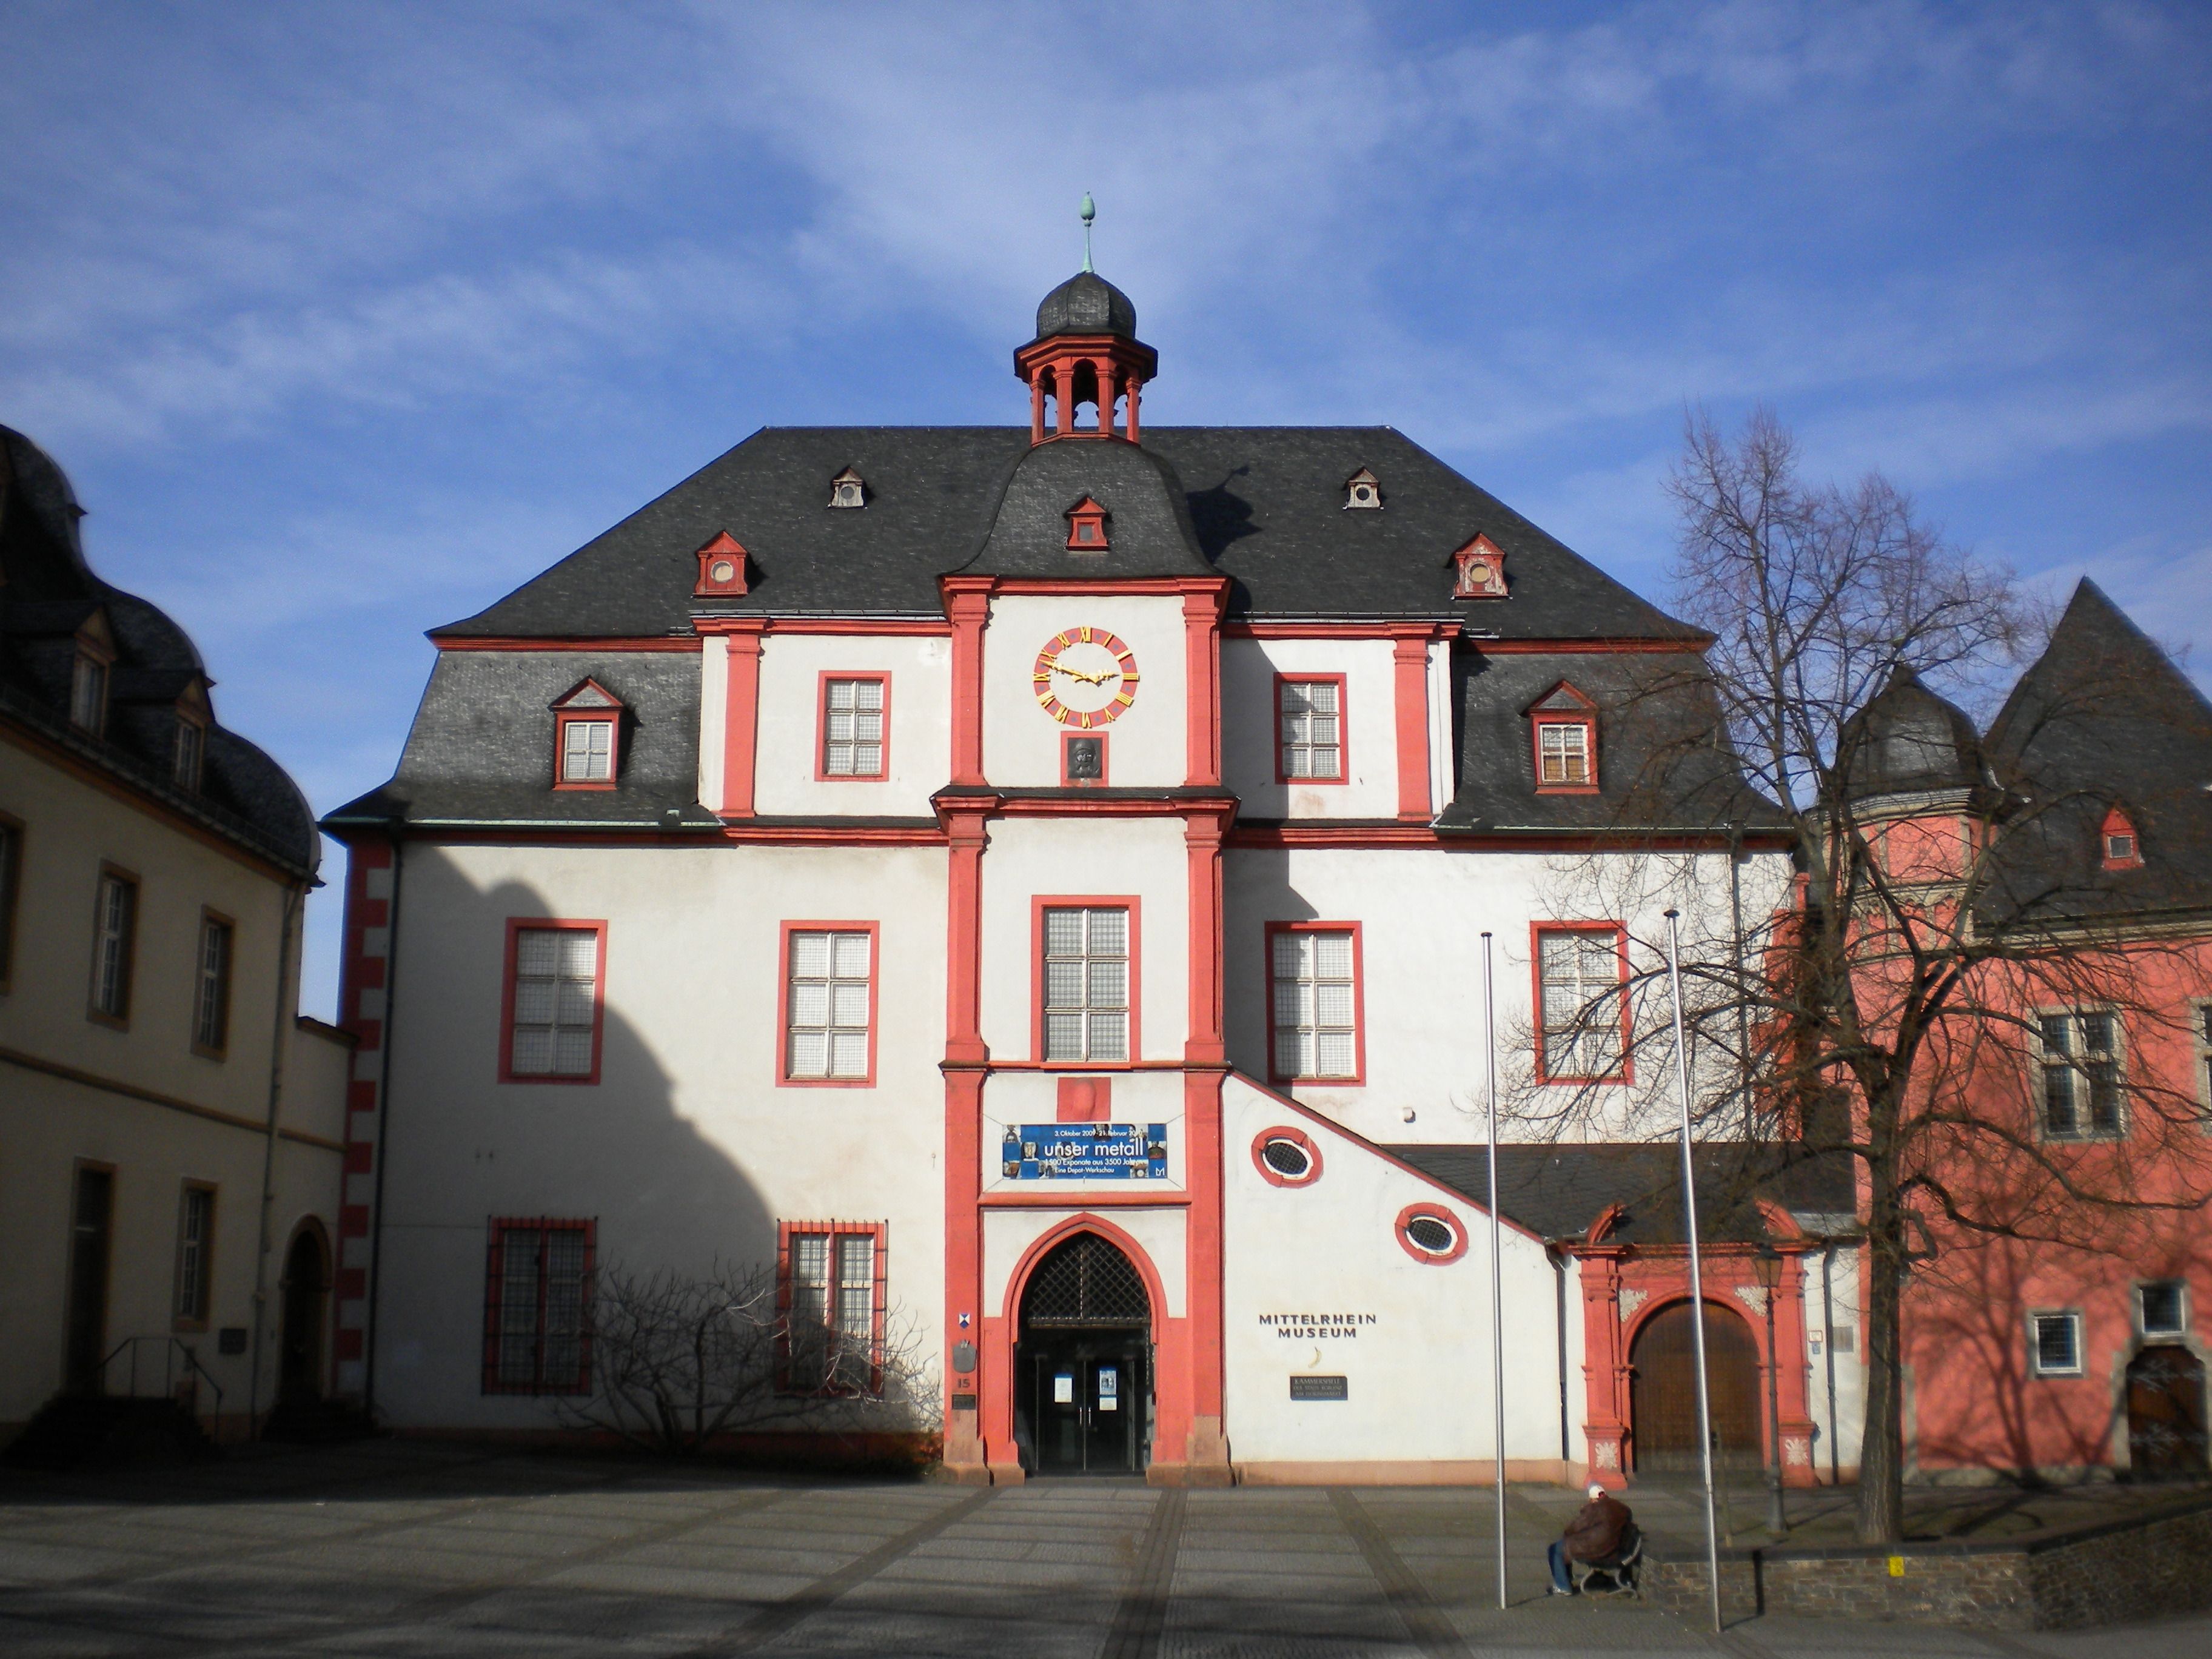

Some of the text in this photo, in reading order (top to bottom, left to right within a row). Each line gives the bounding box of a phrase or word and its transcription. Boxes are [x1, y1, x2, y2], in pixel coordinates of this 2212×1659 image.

[1056, 632, 1071, 649] XI
[1080, 627, 1091, 643] XII
[1044, 1137, 1143, 1156] unser metall
[1259, 1314, 1376, 1325] MITTELRHEIN
[1278, 1327, 1356, 1338] MUSEUM
[958, 1378, 970, 1388] 15
